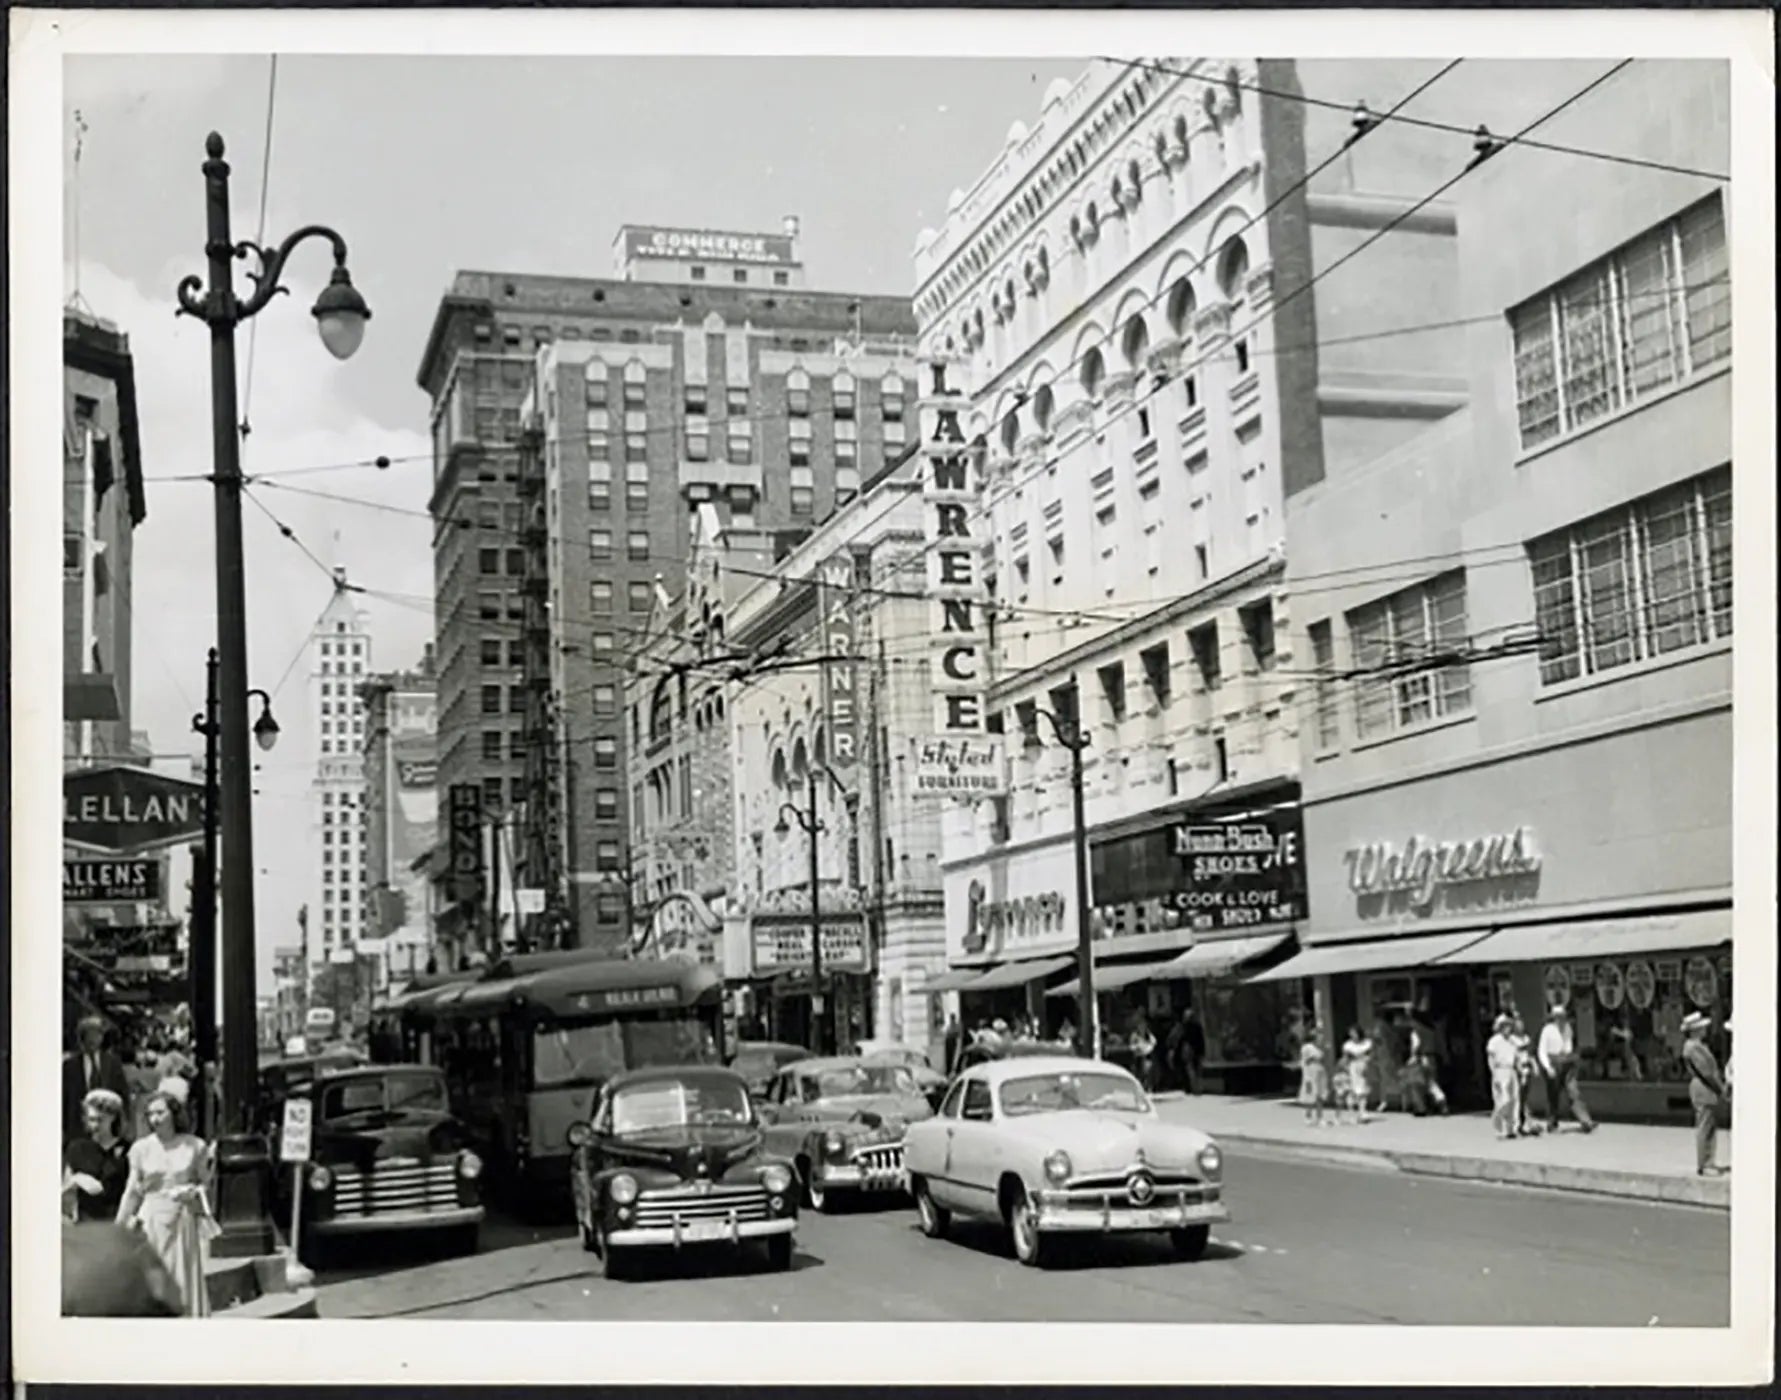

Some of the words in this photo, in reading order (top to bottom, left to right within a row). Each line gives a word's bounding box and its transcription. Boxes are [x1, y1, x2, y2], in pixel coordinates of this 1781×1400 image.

[652, 232, 766, 252] COMMERCE
[930, 364, 980, 730] LAWRENCE
[824, 567, 855, 758] WARNER
[1343, 826, 1543, 906] Walgreens
